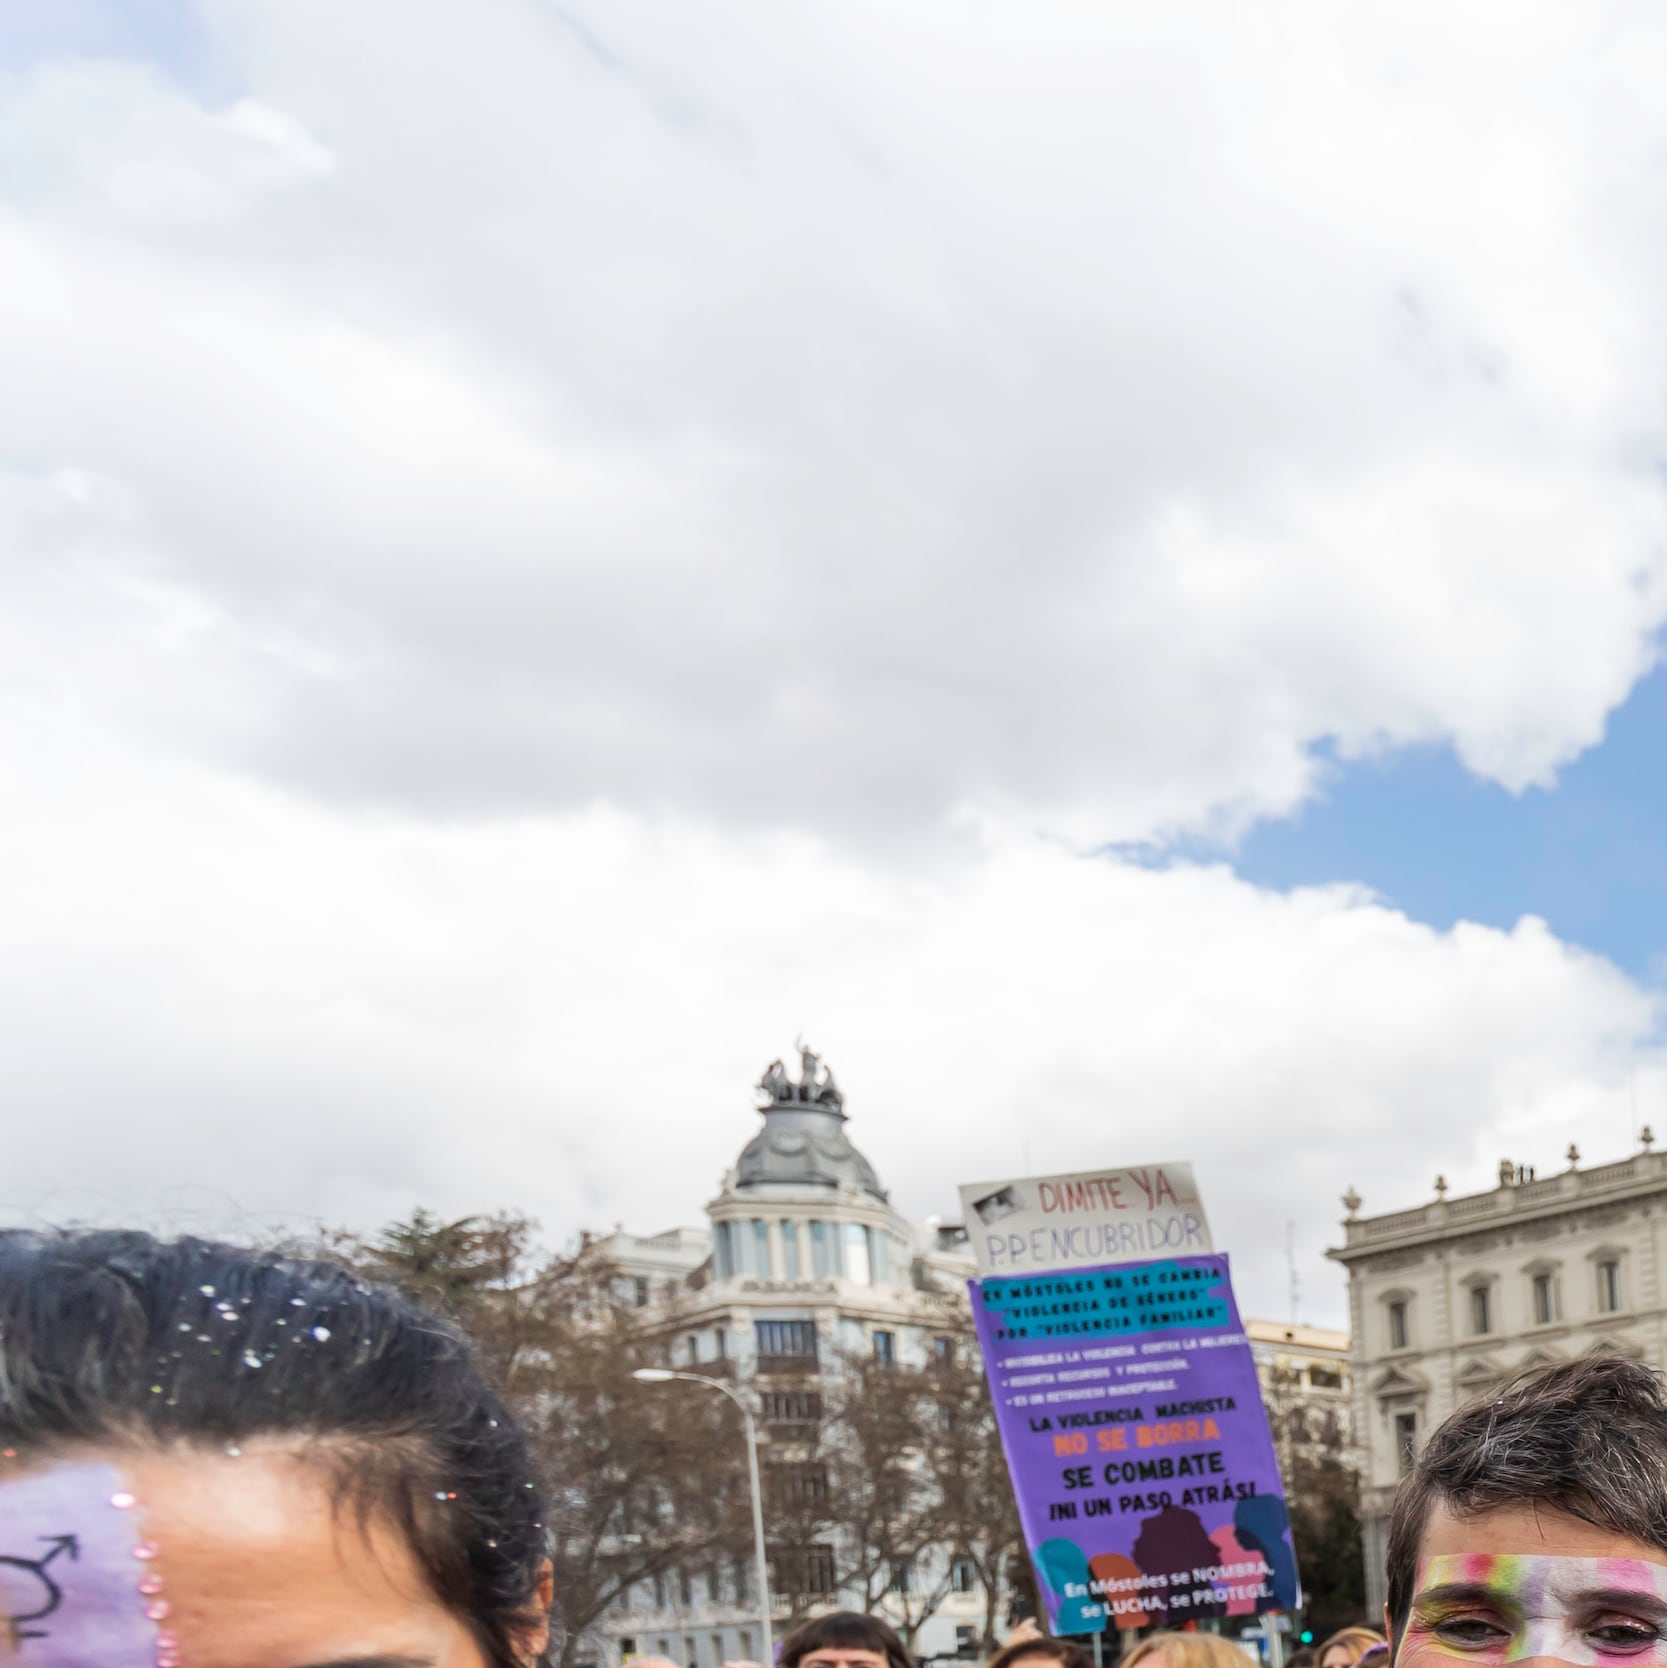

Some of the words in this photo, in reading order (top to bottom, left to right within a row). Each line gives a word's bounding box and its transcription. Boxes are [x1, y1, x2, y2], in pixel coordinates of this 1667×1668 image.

[1038, 1176, 1128, 1213] DIMITE
[1029, 1213, 1204, 1262] ENCUBRIDOR
[1029, 1417, 1053, 1433] LA
[1057, 1406, 1144, 1430] VIOLENCIA
[1155, 1396, 1237, 1419] MACHISTA
[1053, 1432, 1088, 1457] NO
[1096, 1427, 1127, 1452] SE
[1136, 1418, 1220, 1448] BORRA
[1062, 1466, 1094, 1490] SE
[1104, 1452, 1225, 1485] COMBATE
[1084, 1497, 1111, 1518] UN
[1120, 1491, 1172, 1514] PASO
[1063, 1582, 1088, 1599] En
[1089, 1572, 1168, 1596] Móstoles
[1170, 1570, 1190, 1586] se
[1192, 1560, 1275, 1583] NOMBRA,
[1080, 1605, 1102, 1619] se
[1103, 1595, 1168, 1616] LUCHA,
[1170, 1593, 1190, 1608] se
[1192, 1582, 1274, 1605] PROTEGE.
